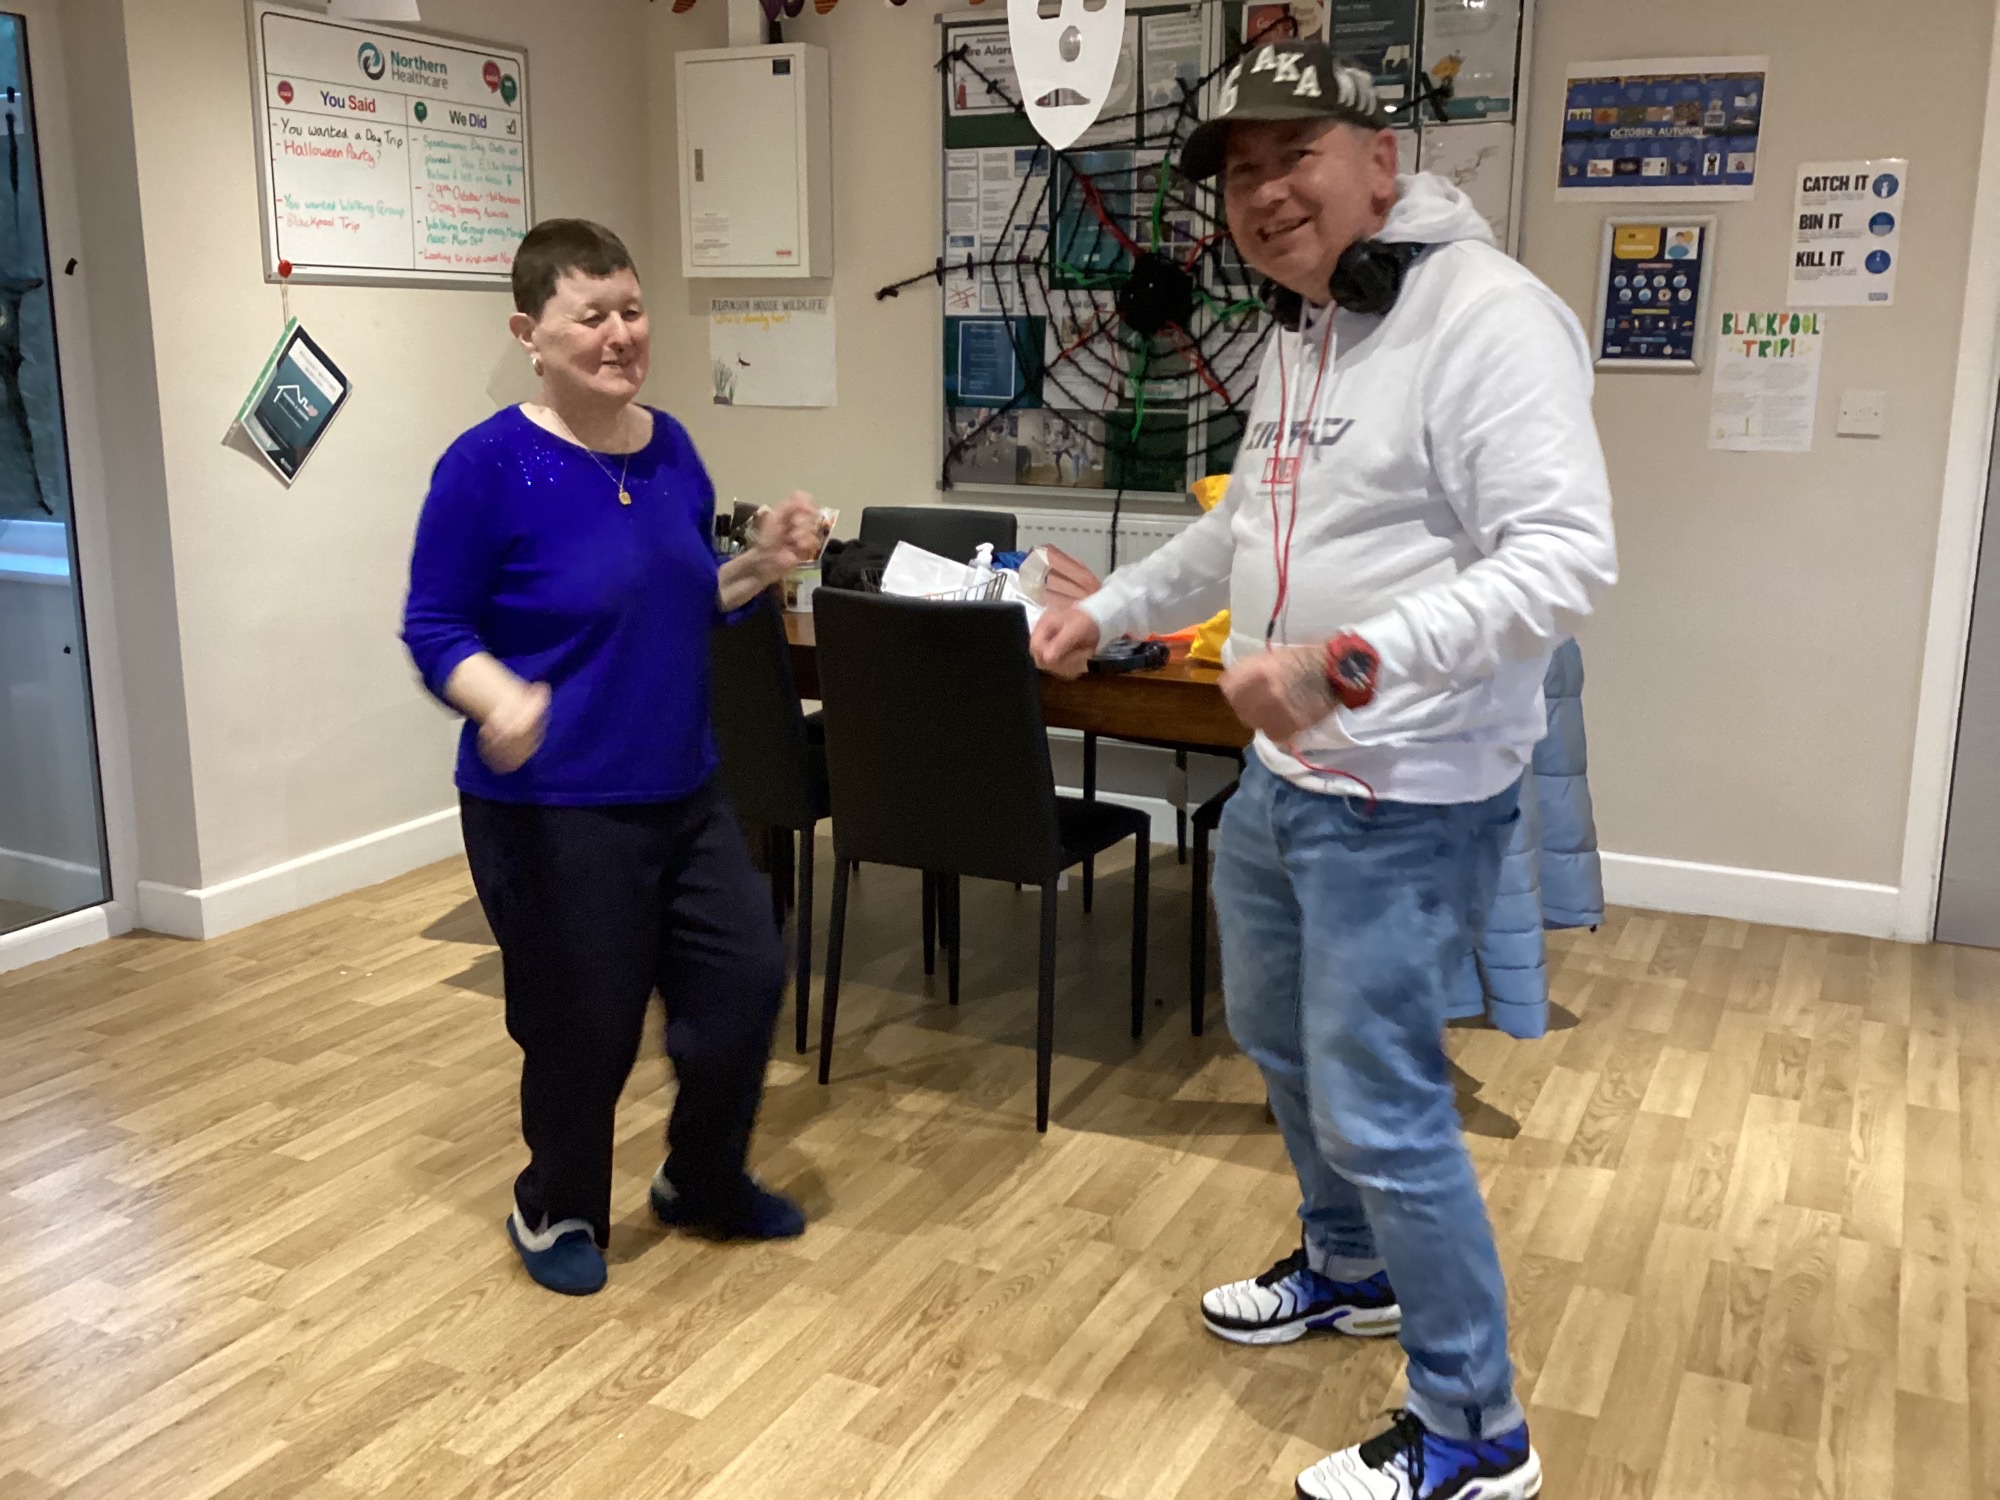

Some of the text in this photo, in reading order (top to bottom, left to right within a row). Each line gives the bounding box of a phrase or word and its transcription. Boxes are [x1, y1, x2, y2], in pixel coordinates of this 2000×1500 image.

[984, 45, 1012, 56] Alar
[390, 50, 448, 75] Northern
[392, 68, 448, 90] Healthcare
[320, 90, 376, 113] You Said
[450, 110, 487, 129] We Did
[281, 117, 403, 149] You wanted a Day Trip
[1610, 126, 1703, 139] OCTOBER: AUTUMN
[284, 139, 343, 158] Halloween
[1802, 174, 1870, 192] CATCH IT
[284, 193, 300, 210] You
[305, 201, 336, 211] wanted
[376, 200, 406, 218] Group
[286, 212, 361, 233] Blackpool Trip
[1798, 213, 1843, 230] BIN IT
[1795, 250, 1845, 267] KILL IT
[782, 299, 825, 310] WILDLIFE
[1721, 312, 1820, 336] BLACKPOOL
[1742, 338, 1796, 358] TRIP!
